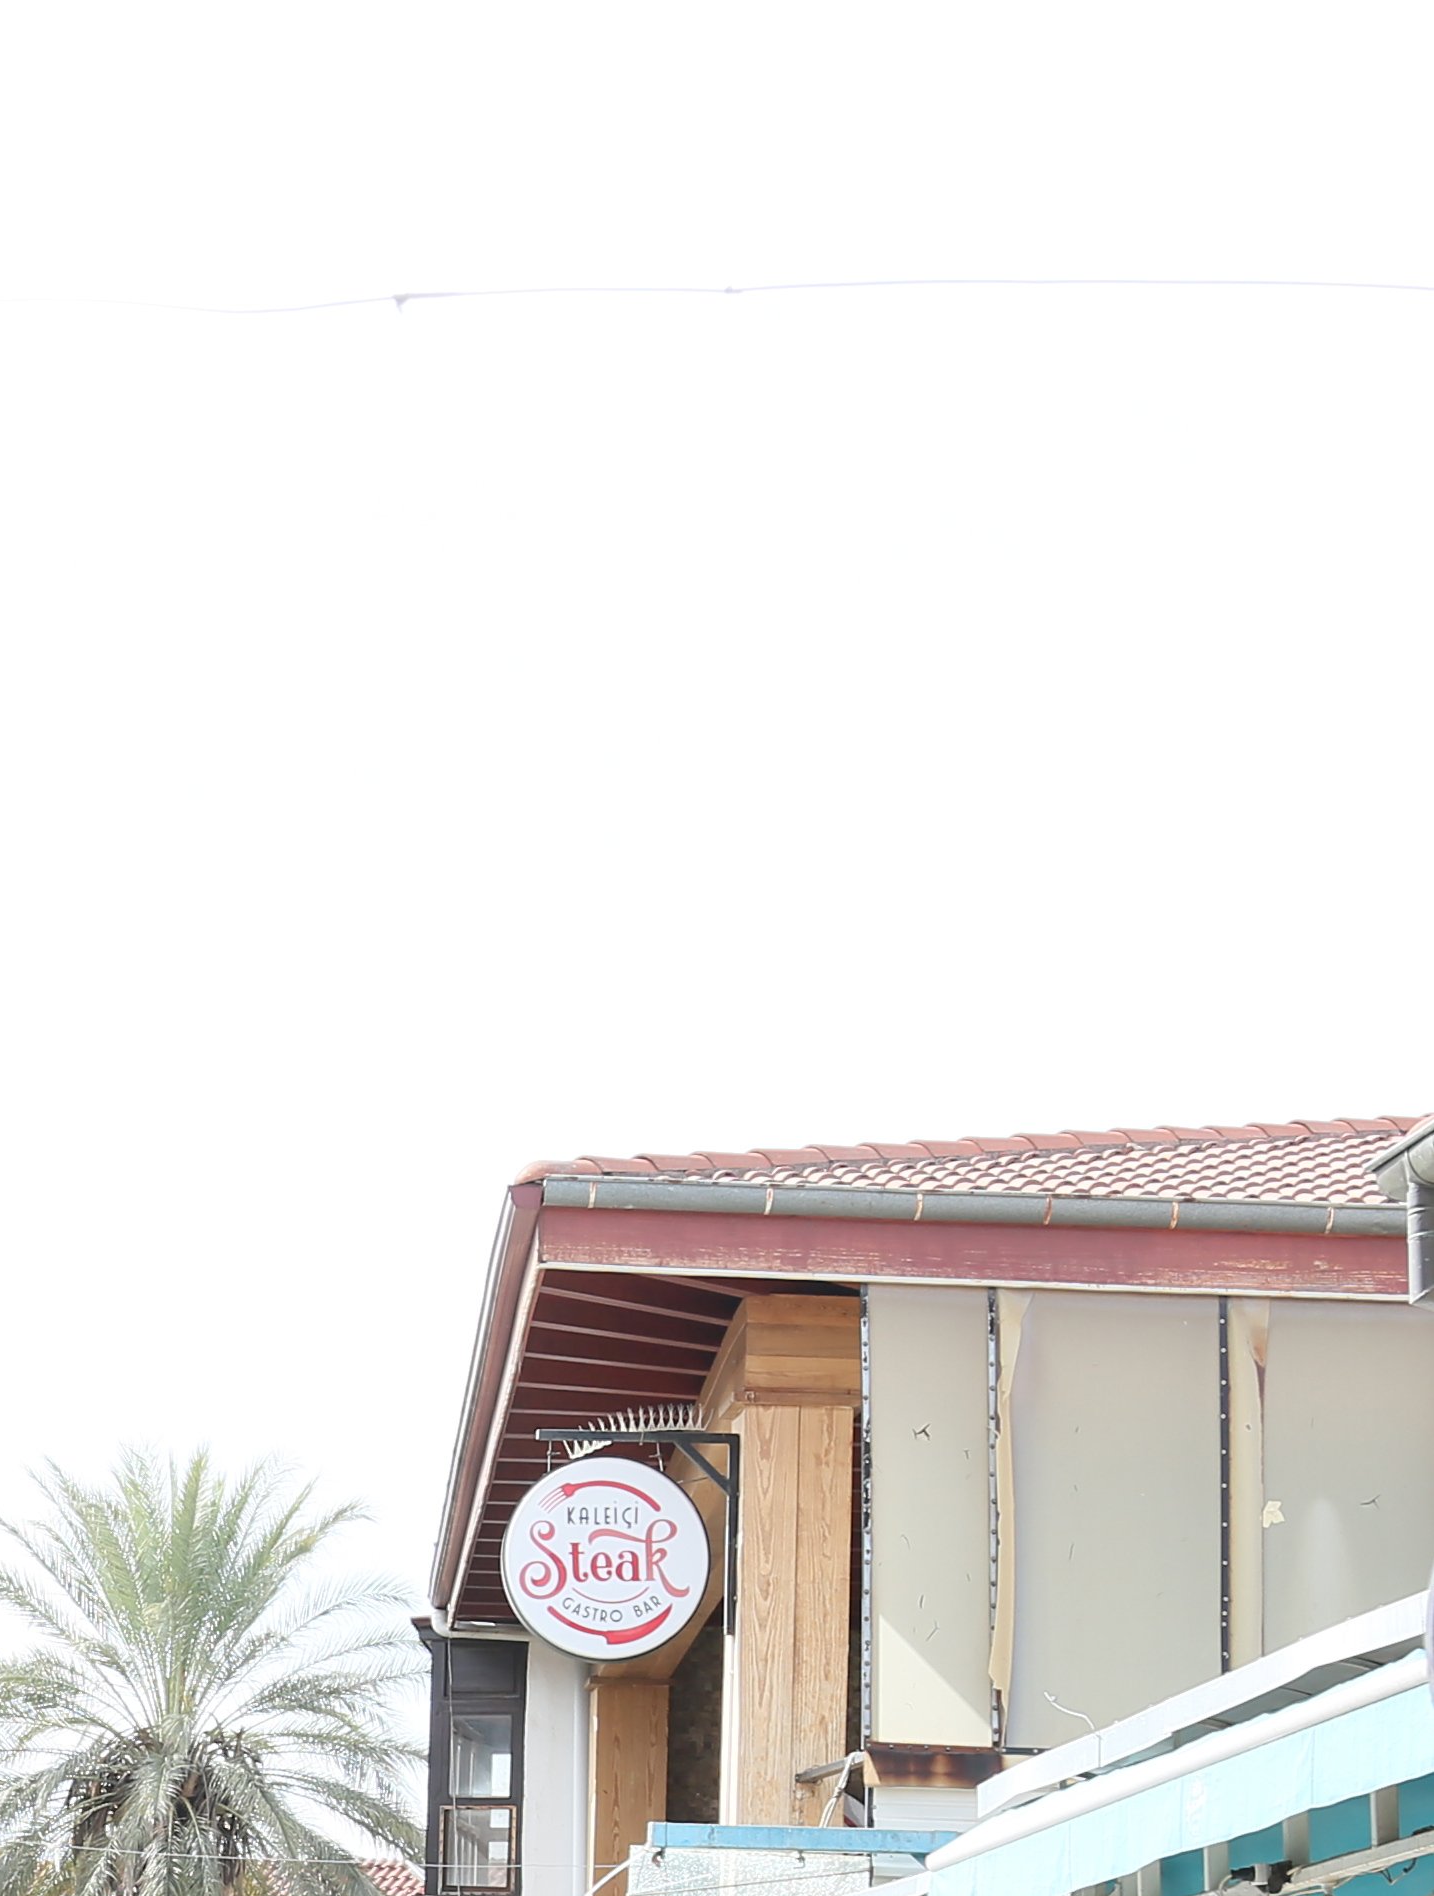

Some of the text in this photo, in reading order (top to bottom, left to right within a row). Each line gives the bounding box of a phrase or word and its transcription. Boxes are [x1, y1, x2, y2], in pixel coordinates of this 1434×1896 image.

[566, 1500, 639, 1529] KALEİÇİ
[519, 1518, 690, 1600] Steak
[562, 1595, 662, 1623] GASTRO BAR
